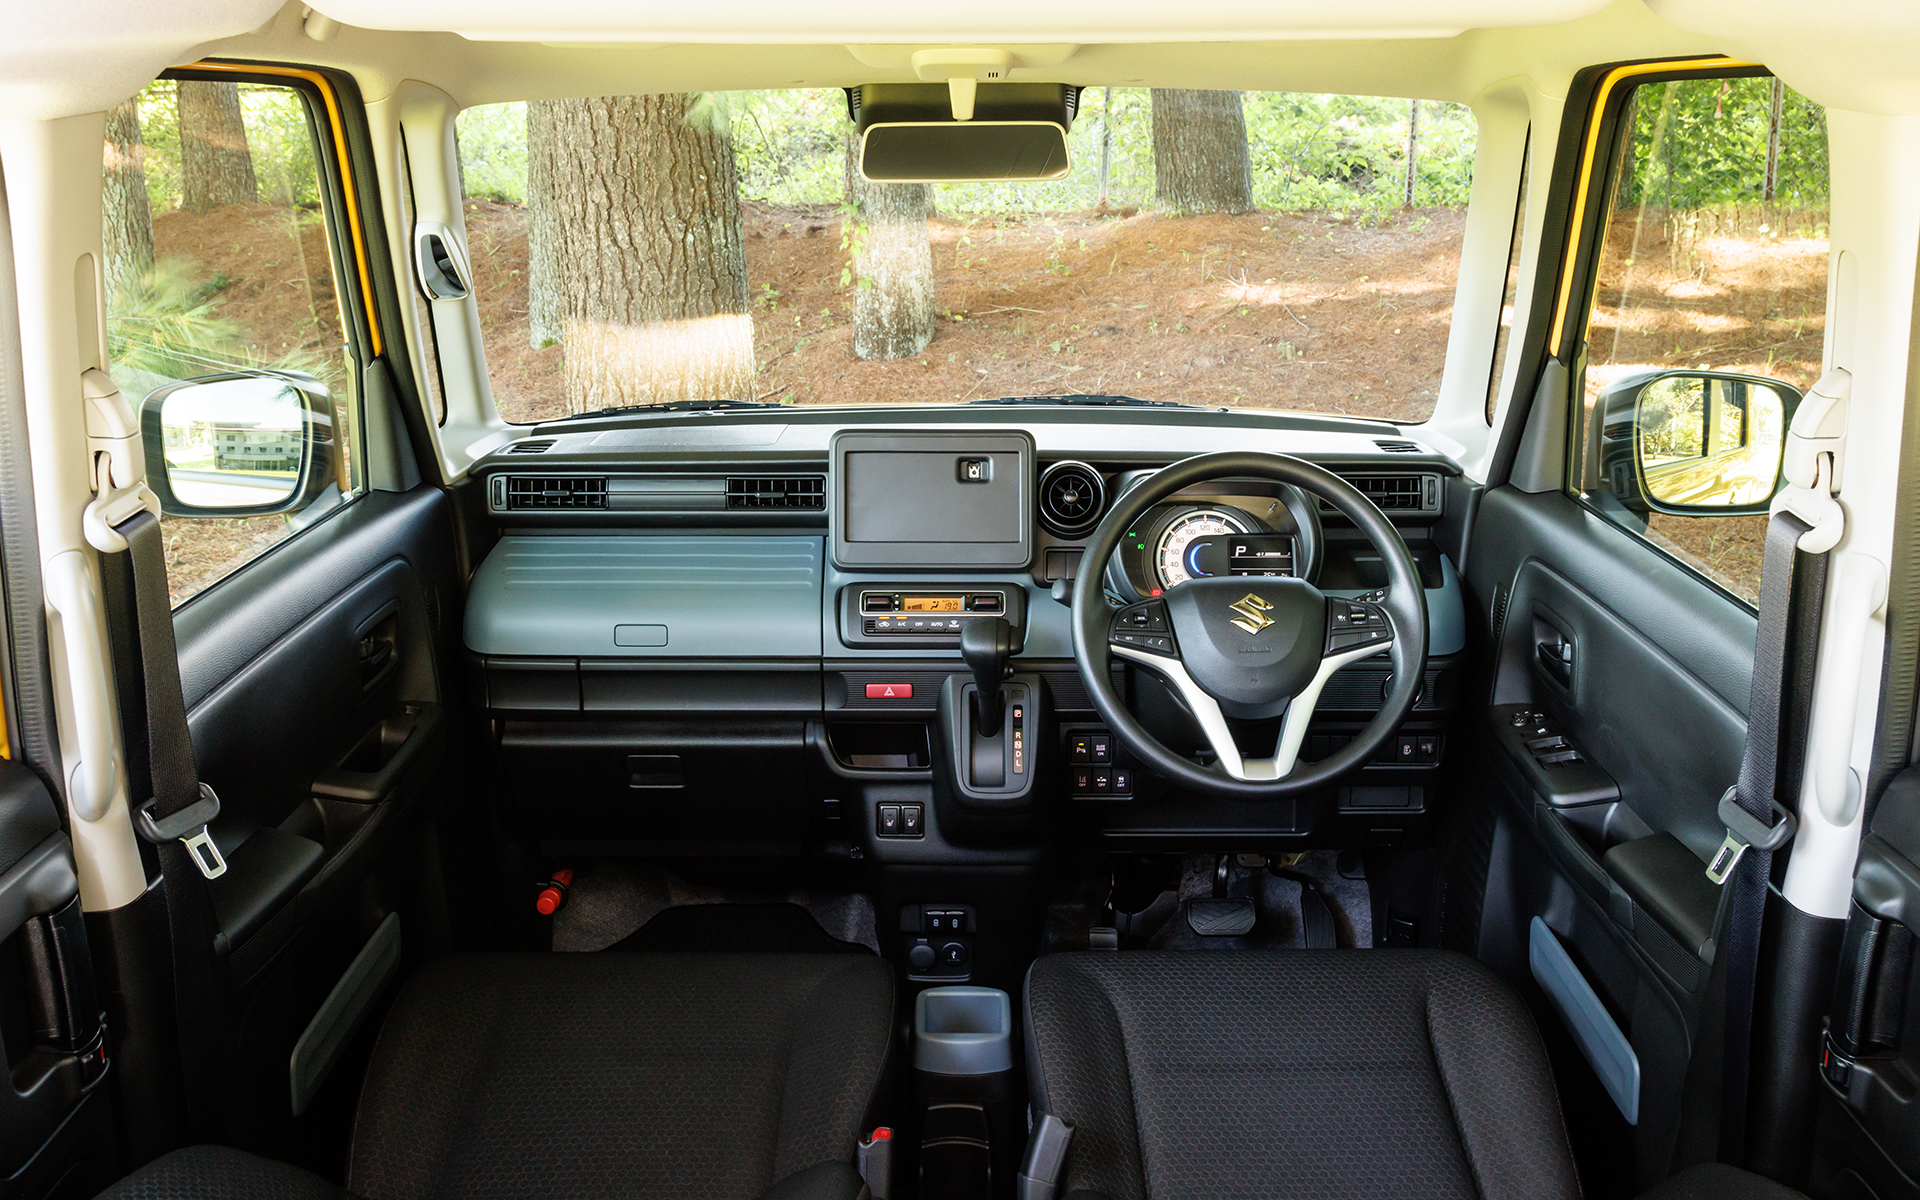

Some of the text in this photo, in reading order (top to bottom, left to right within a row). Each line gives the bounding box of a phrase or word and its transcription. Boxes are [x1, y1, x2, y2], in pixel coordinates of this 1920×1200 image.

[1235, 546, 1247, 557] P
[1015, 731, 1021, 739] R
[1015, 750, 1022, 758] D
[1015, 759, 1021, 767] L
